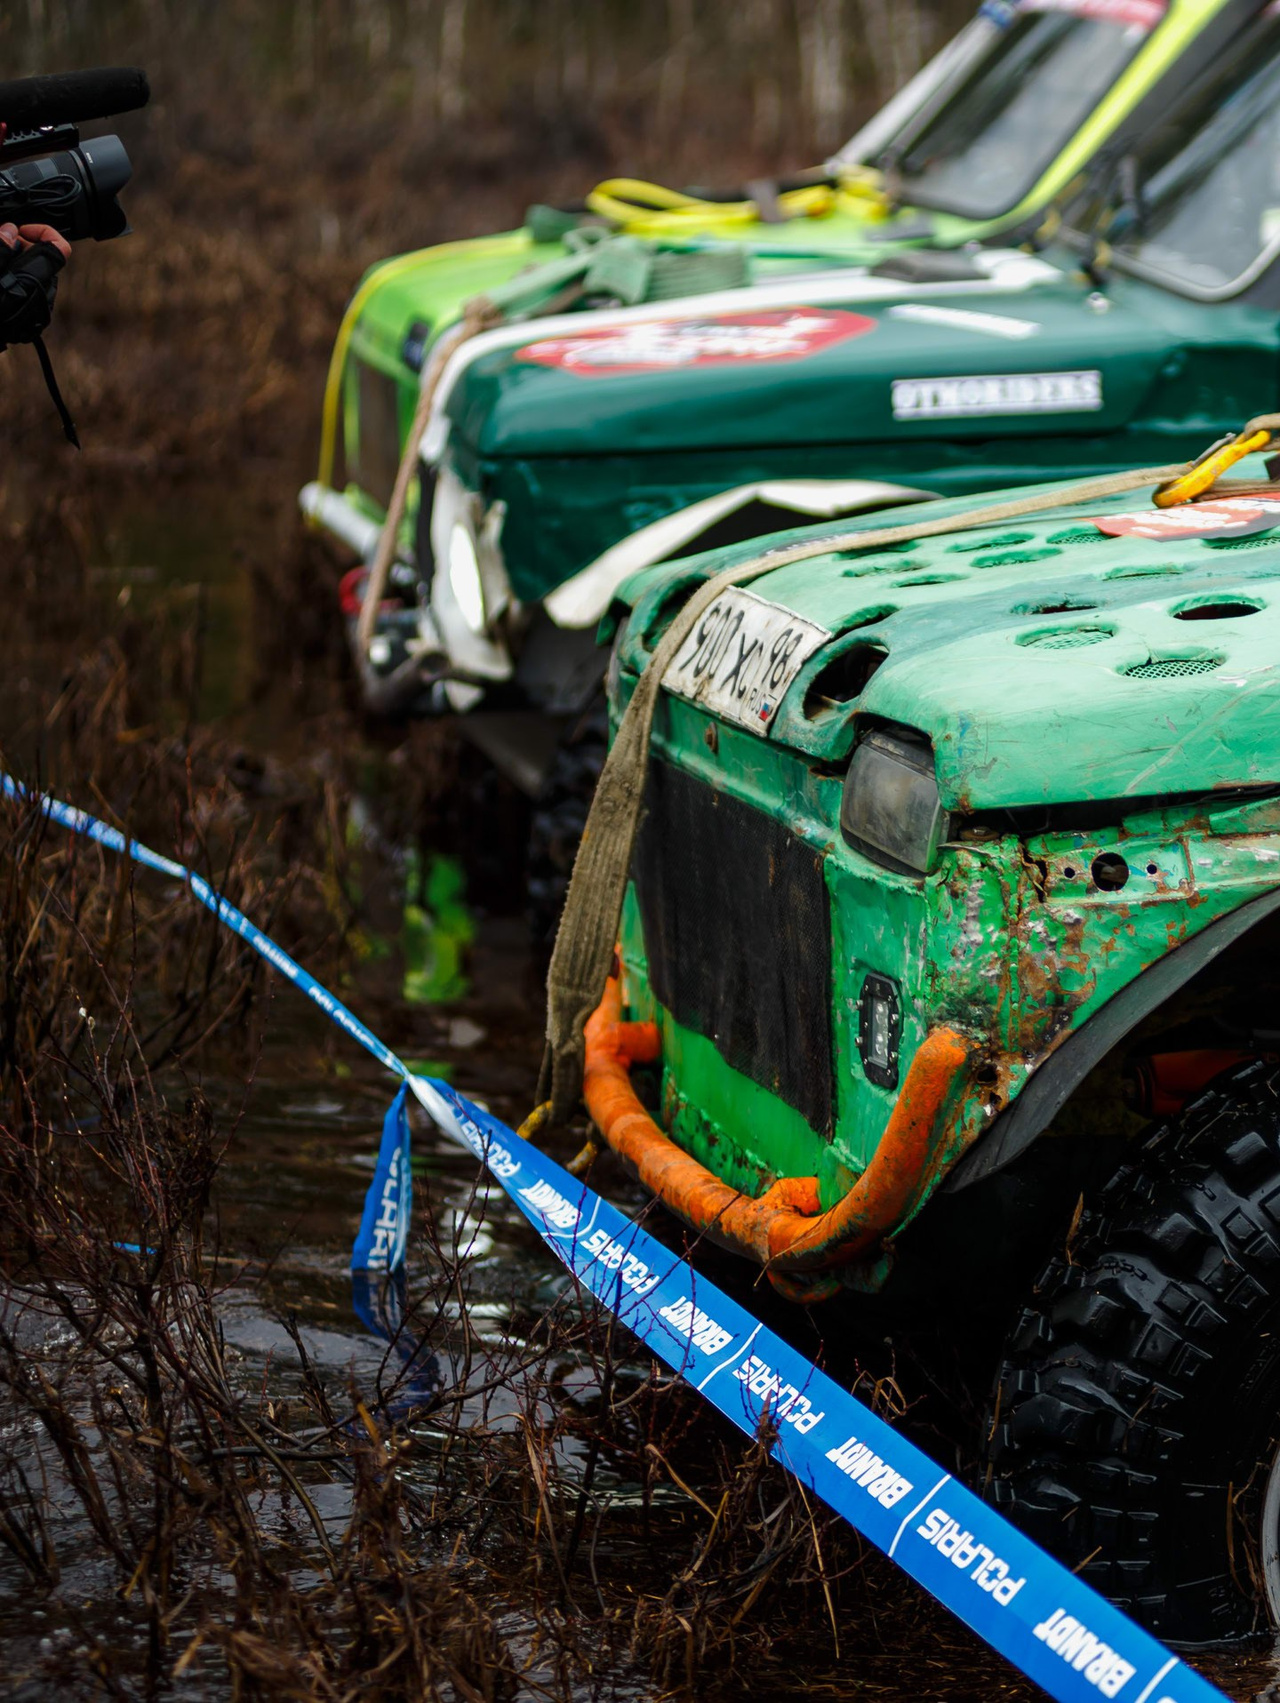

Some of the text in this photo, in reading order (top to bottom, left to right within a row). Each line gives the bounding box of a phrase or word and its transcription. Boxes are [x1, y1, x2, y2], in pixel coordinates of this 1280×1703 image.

[761, 627, 804, 690] 98
[517, 1178, 584, 1229] BRANDT
[580, 1228, 735, 1356] BRANDT POLARIS
[731, 1354, 914, 1510] BRANDT POLARIS
[915, 1507, 1137, 1699] BRANDT POLARIS
